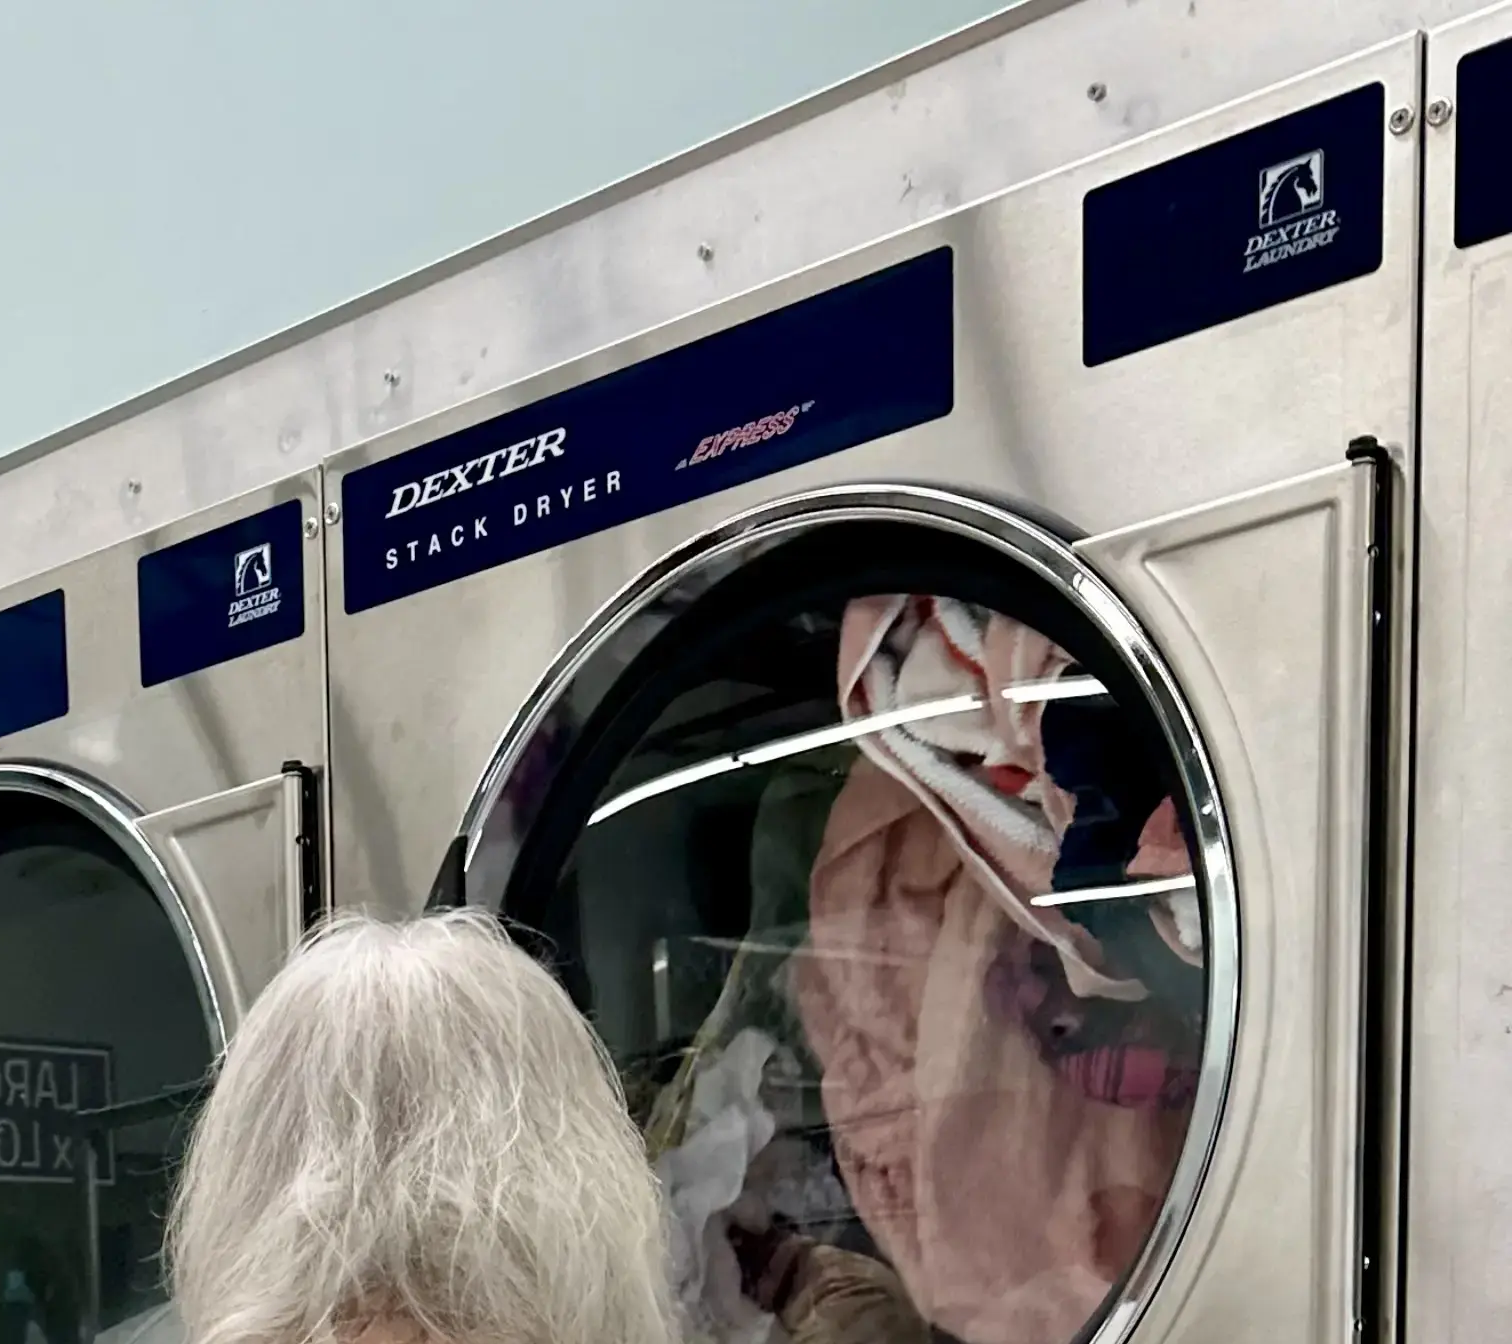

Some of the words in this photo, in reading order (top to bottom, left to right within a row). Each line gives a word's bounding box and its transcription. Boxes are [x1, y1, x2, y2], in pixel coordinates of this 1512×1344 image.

[1243, 226, 1341, 274] LAUNDRY
[1244, 209, 1337, 256] DEXTER
[688, 404, 800, 467] EXPRESS
[384, 426, 567, 519] DEXTER
[386, 517, 489, 570] STACK
[514, 469, 622, 527] DRYER
[228, 587, 280, 616] DEXTER
[228, 600, 281, 628] LAUNDRY
